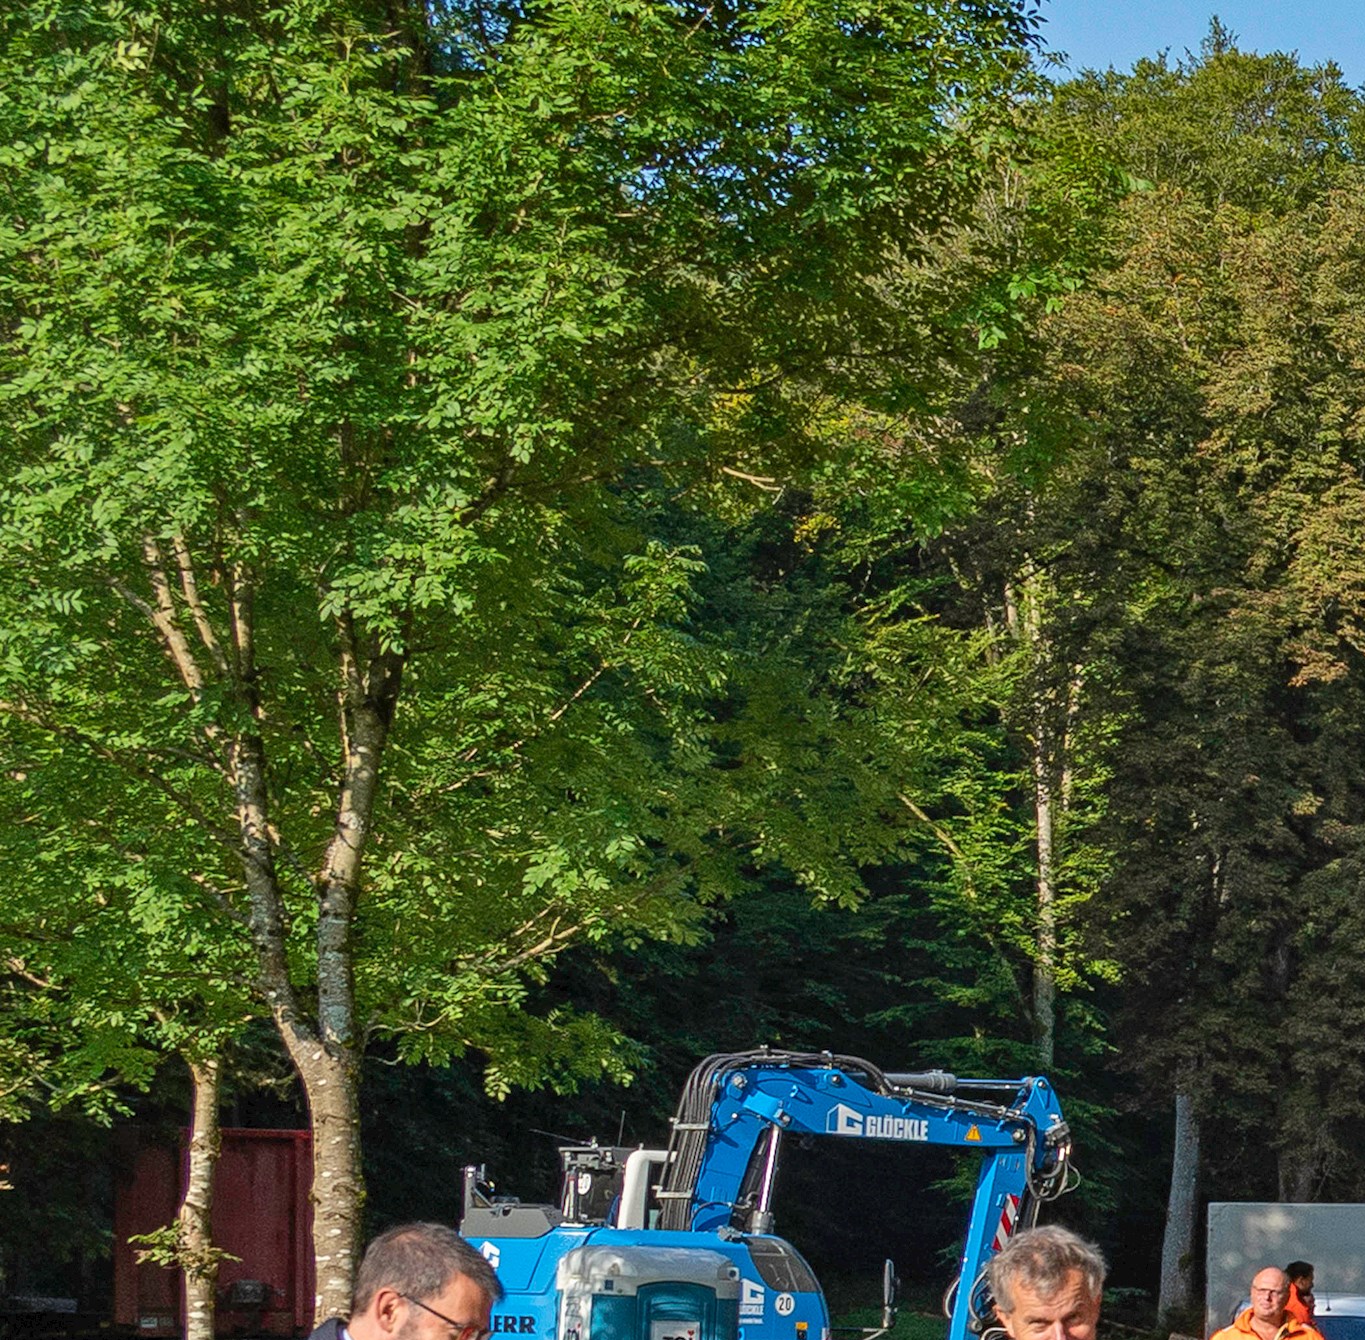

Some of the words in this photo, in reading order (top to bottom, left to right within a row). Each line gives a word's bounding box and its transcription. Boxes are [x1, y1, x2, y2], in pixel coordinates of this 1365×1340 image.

[865, 1114, 929, 1141] GLÖCKLE
[778, 1297, 792, 1311] 20
[493, 1314, 537, 1335] ERR
